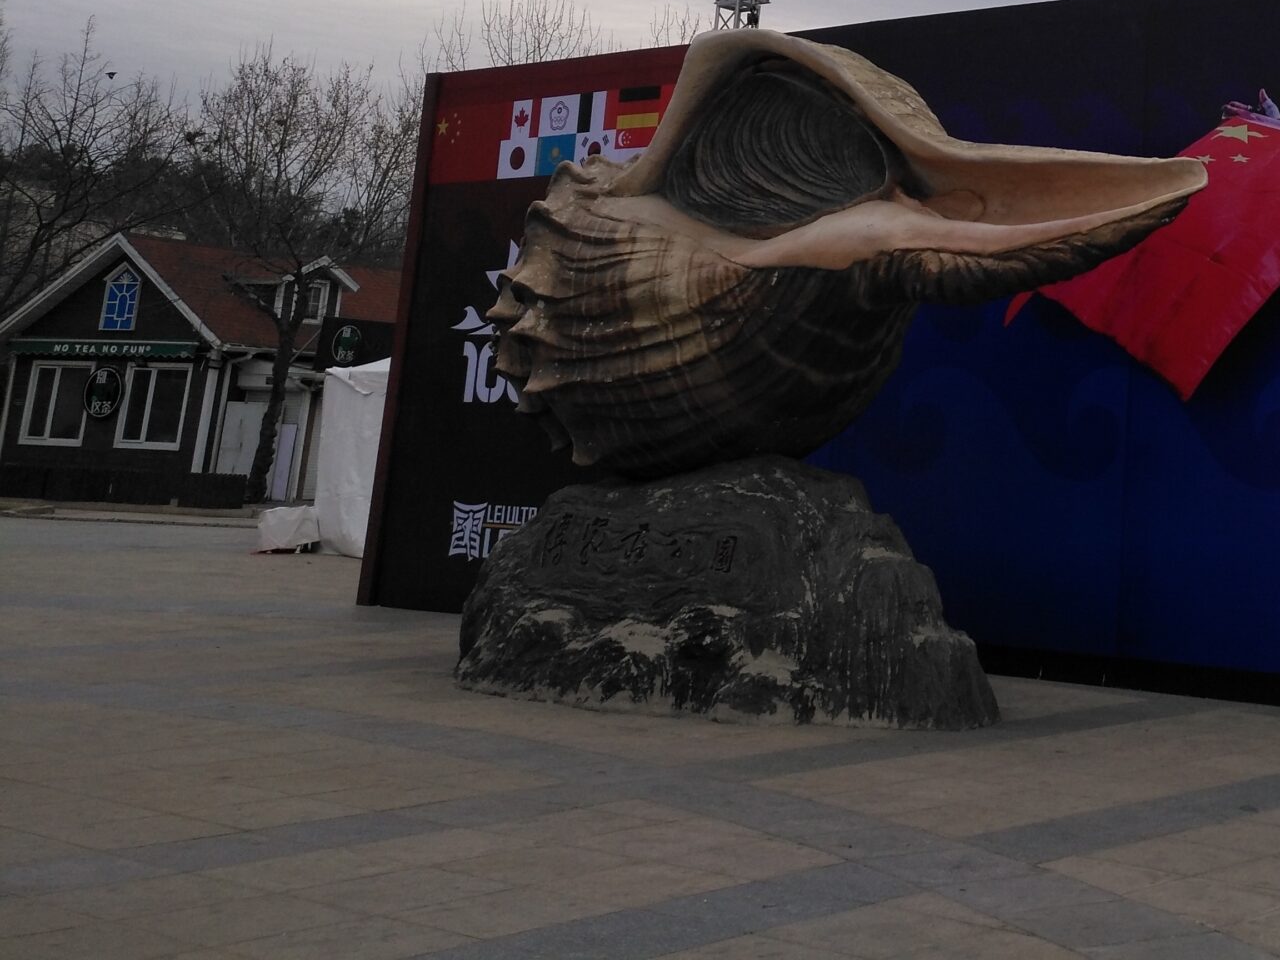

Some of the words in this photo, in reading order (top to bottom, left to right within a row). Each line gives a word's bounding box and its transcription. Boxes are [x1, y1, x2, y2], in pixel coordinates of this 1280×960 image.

[53, 344, 69, 353] NO
[75, 344, 96, 353] TEA
[102, 345, 118, 353] NO
[463, 341, 520, 403] 10
[487, 504, 504, 523] LEI
